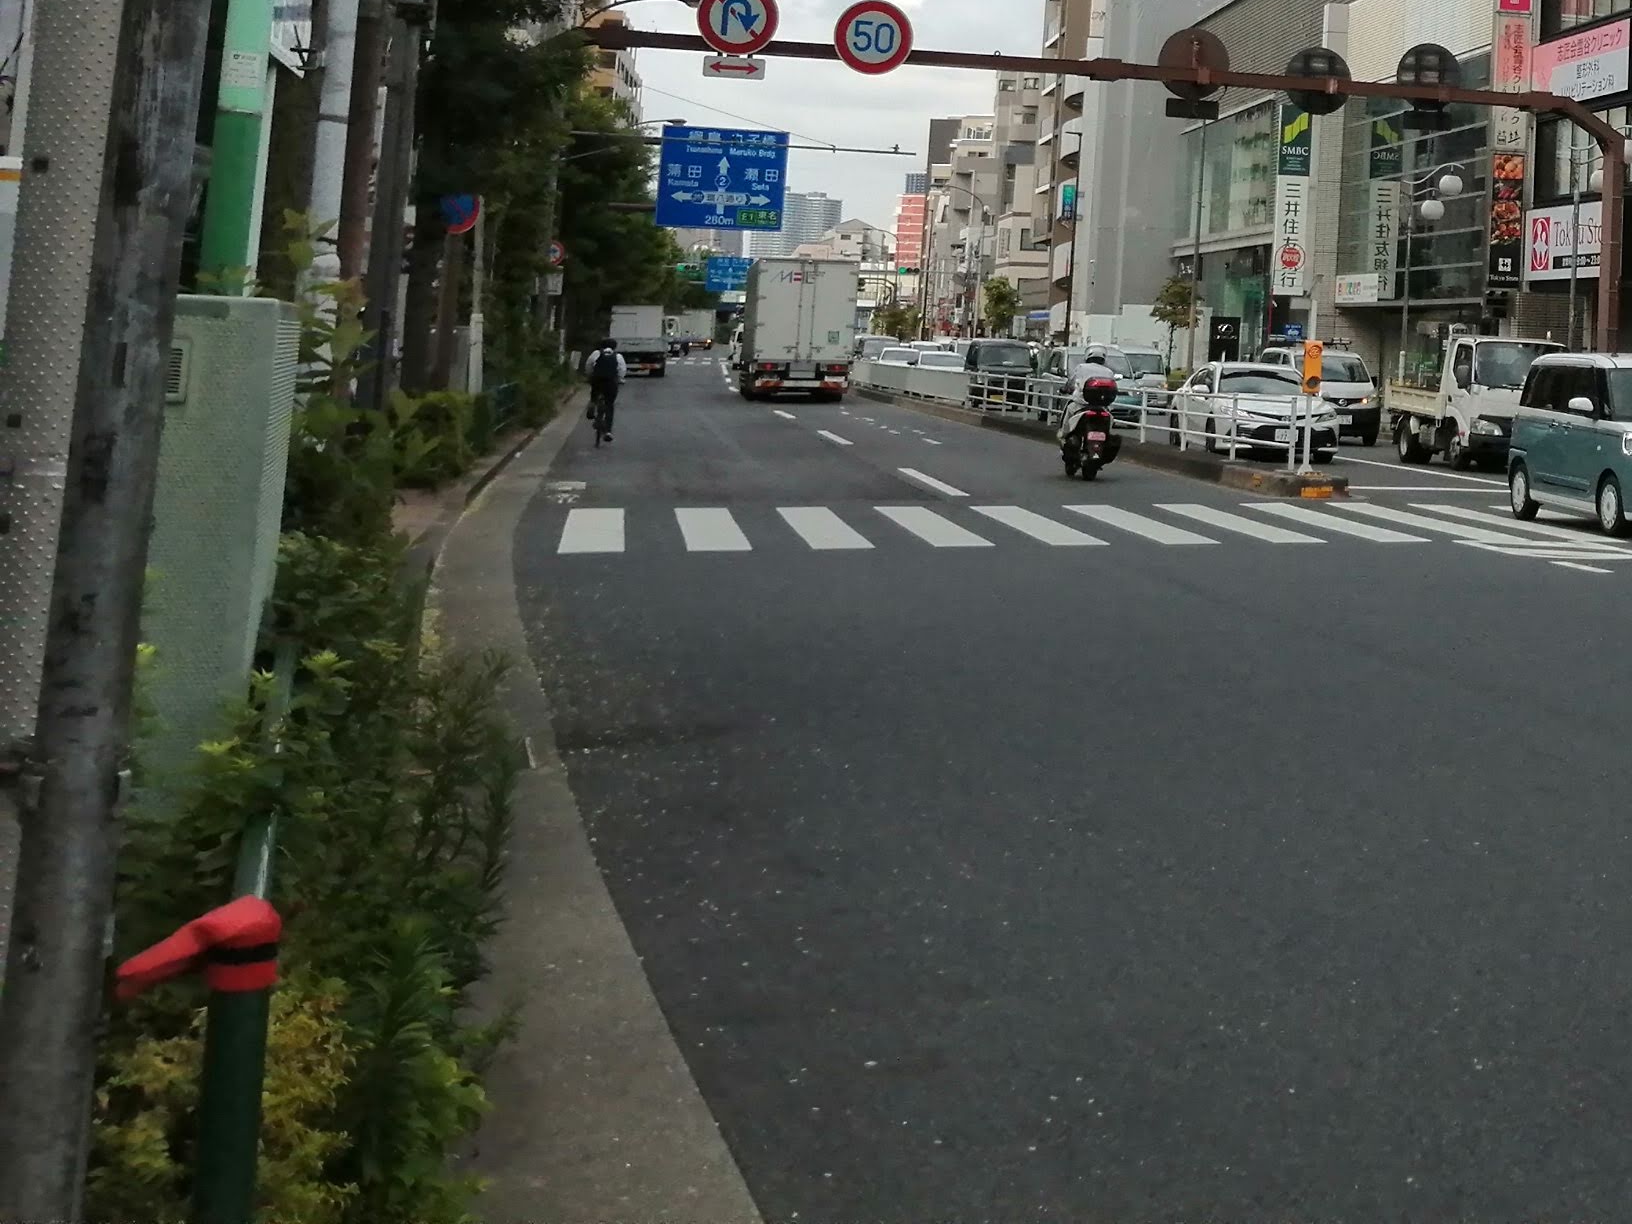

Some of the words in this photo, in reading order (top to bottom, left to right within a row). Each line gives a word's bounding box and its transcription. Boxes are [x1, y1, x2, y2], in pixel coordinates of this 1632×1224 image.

[852, 20, 895, 54] 50
[1281, 145, 1309, 156] SMBC
[719, 176, 727, 186] 2
[704, 214, 734, 225] 280m
